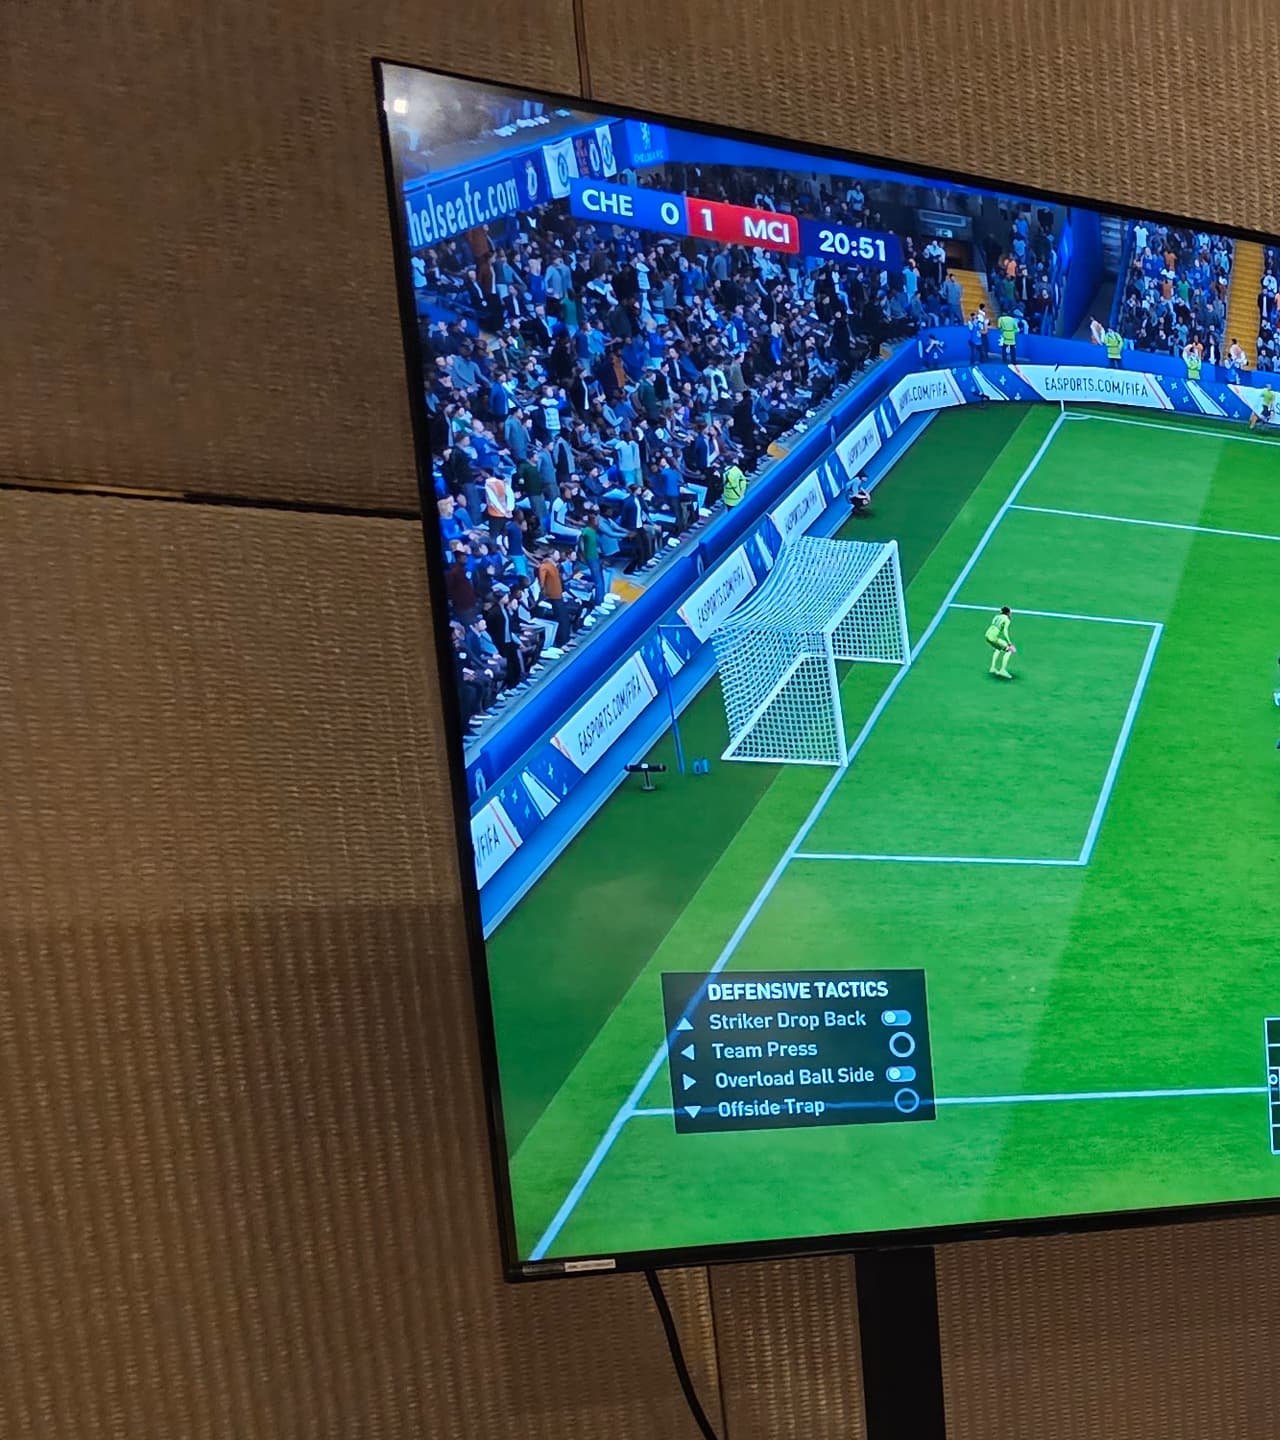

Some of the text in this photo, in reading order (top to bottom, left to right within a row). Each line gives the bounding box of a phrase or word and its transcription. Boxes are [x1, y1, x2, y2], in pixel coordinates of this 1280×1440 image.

[582, 189, 886, 262] CHE 0 1 MCI 20:51
[1045, 377, 1148, 398] EASPORTS.COM/FIFA
[577, 674, 642, 755] EASPORTS.COM/FIFA
[707, 981, 889, 1001] DEFENSIVE TACTICS
[709, 1010, 867, 1031] Striker Drop Back
[712, 1041, 818, 1059] Team Press
[715, 1067, 875, 1088] Overload Ball Side
[718, 1099, 825, 1118] Offside Trap
